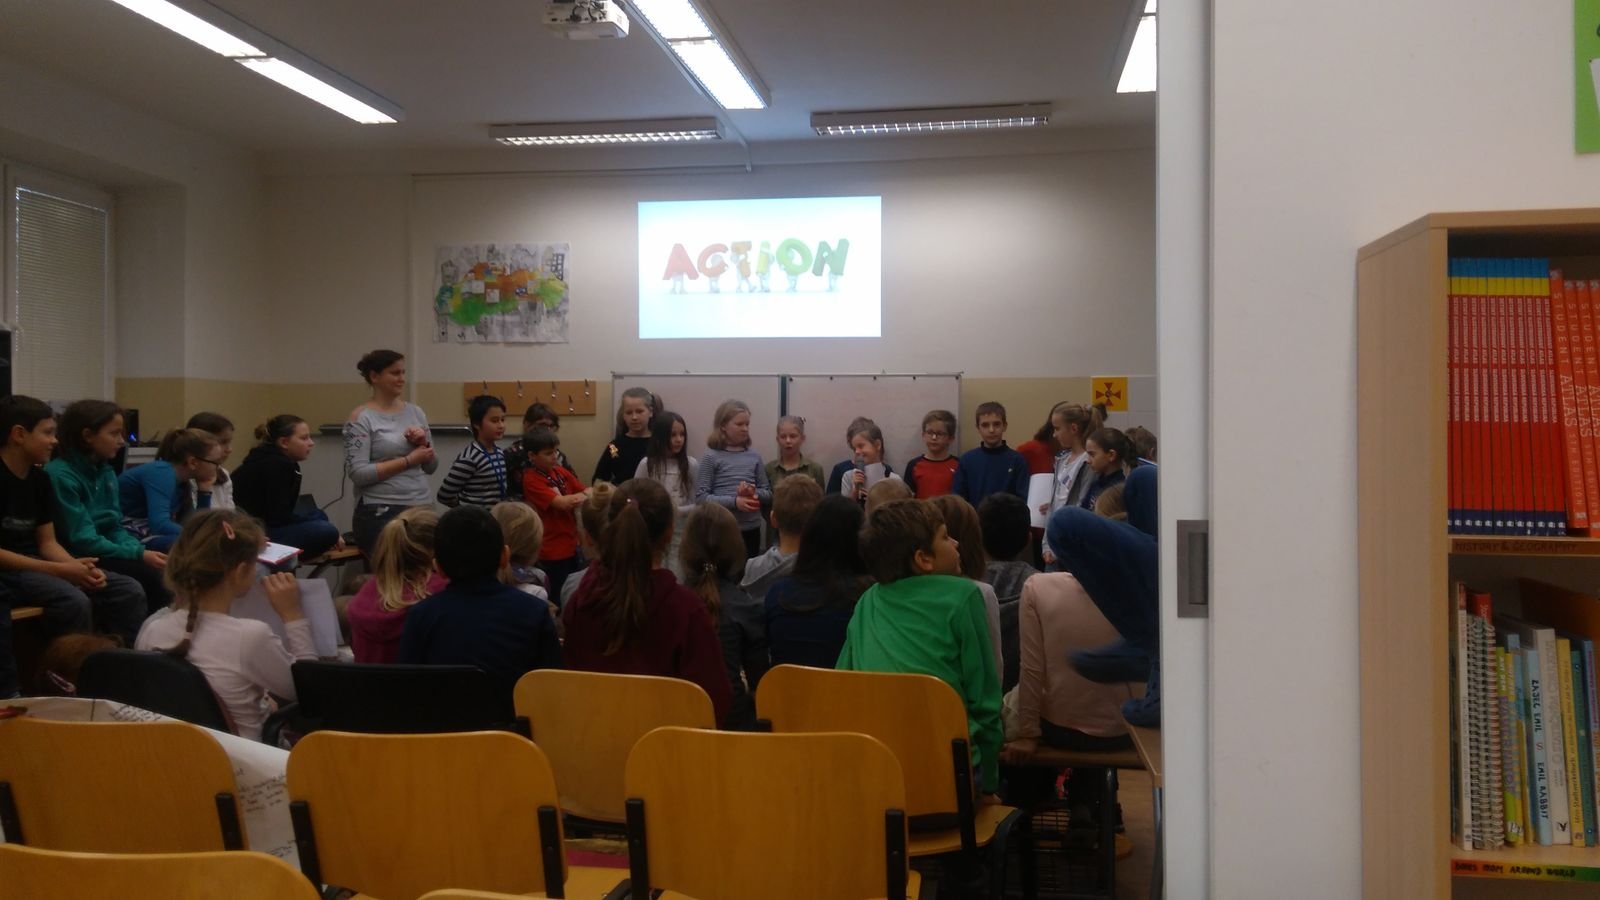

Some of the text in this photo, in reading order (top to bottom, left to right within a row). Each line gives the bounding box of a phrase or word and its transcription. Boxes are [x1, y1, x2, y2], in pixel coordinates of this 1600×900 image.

[1554, 292, 1569, 365] STUDENT
[1568, 303, 1584, 375] STUDENT
[1581, 303, 1597, 376] STUDENT
[1560, 374, 1578, 427] ATLAS
[1575, 384, 1592, 438] ATLAS
[1532, 680, 1542, 732] ZAJEC EMIL
[1538, 762, 1548, 819] EMIL RABBIT
